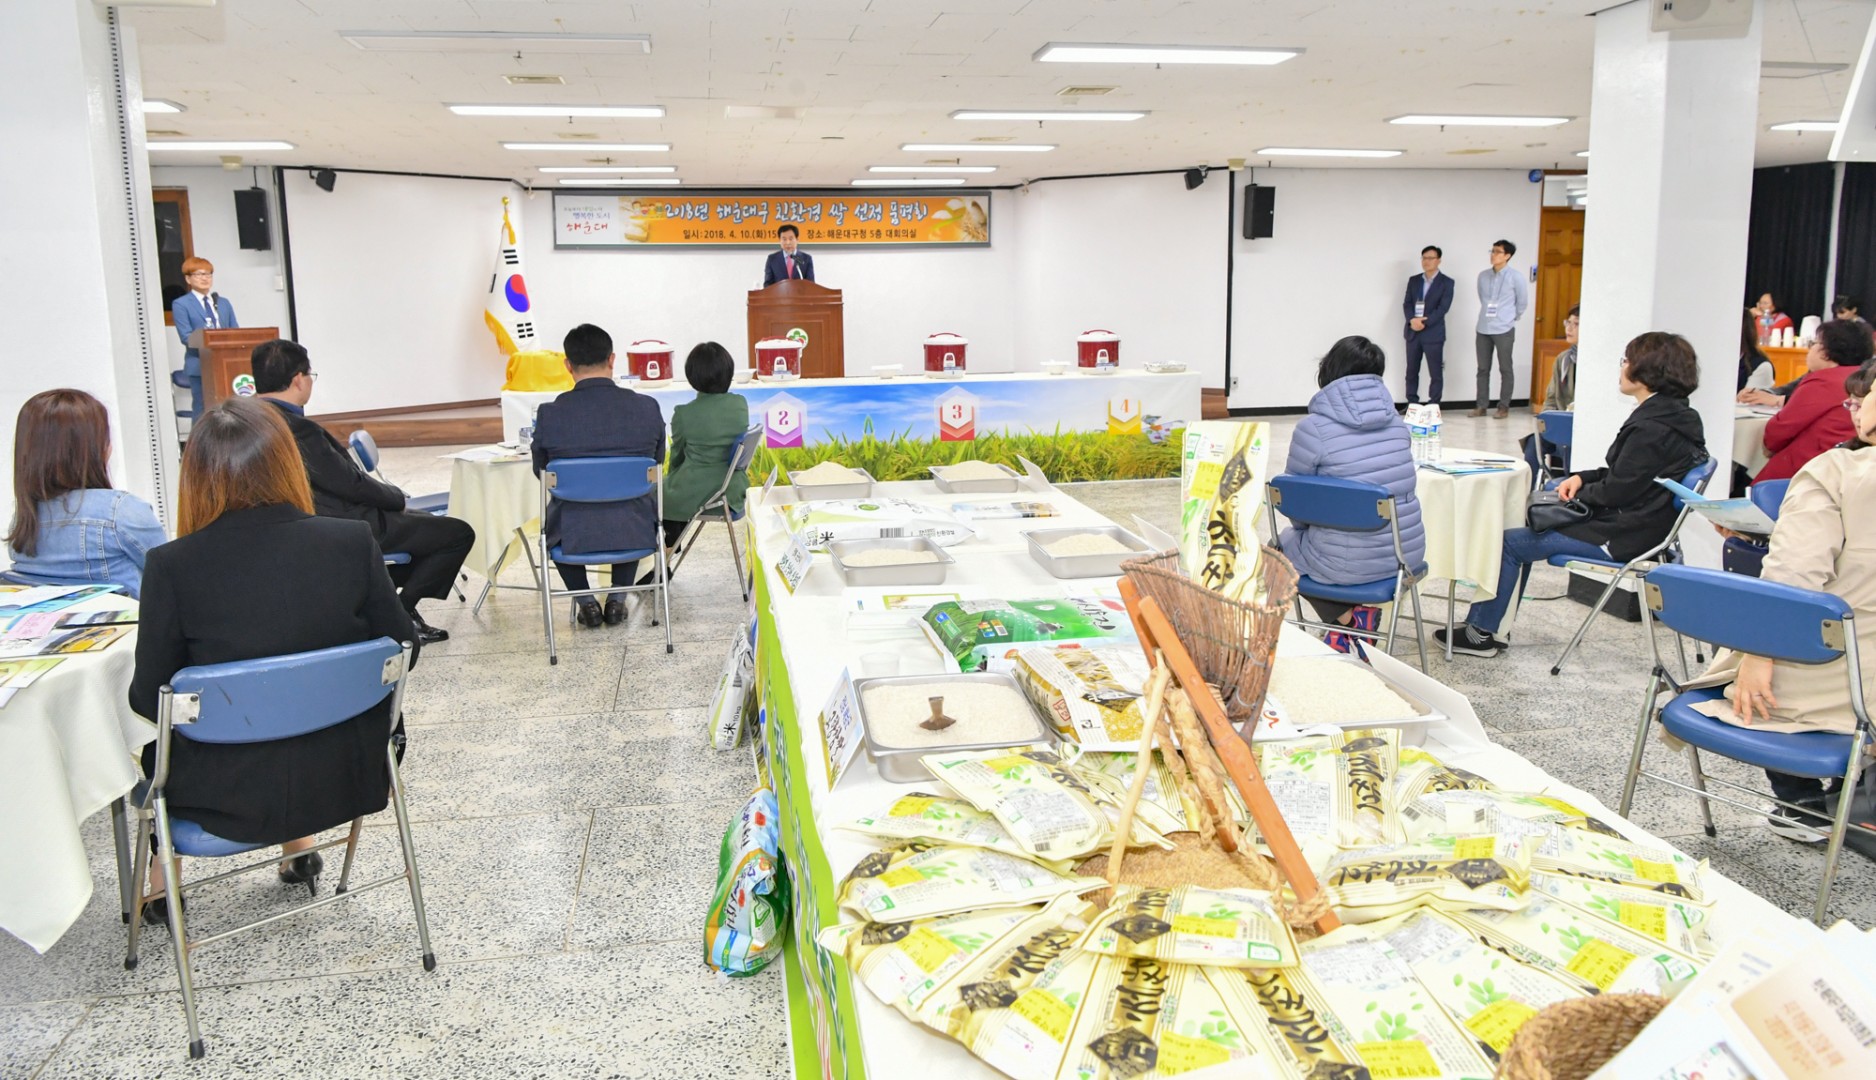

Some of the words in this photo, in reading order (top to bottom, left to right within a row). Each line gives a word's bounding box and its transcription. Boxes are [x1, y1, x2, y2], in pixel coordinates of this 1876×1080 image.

[664, 202, 709, 221] 2018년
[716, 201, 769, 224] 해운대구
[775, 202, 822, 223] 친환경
[828, 202, 848, 226] 쌀
[854, 202, 883, 222] 선정
[889, 201, 929, 226] 품평회
[566, 221, 608, 234] 해운대
[870, 229, 882, 239] 5층
[886, 229, 917, 239] 대회의실
[778, 410, 789, 425] 2
[952, 404, 962, 419] 3
[819, 531, 834, 547] 米
